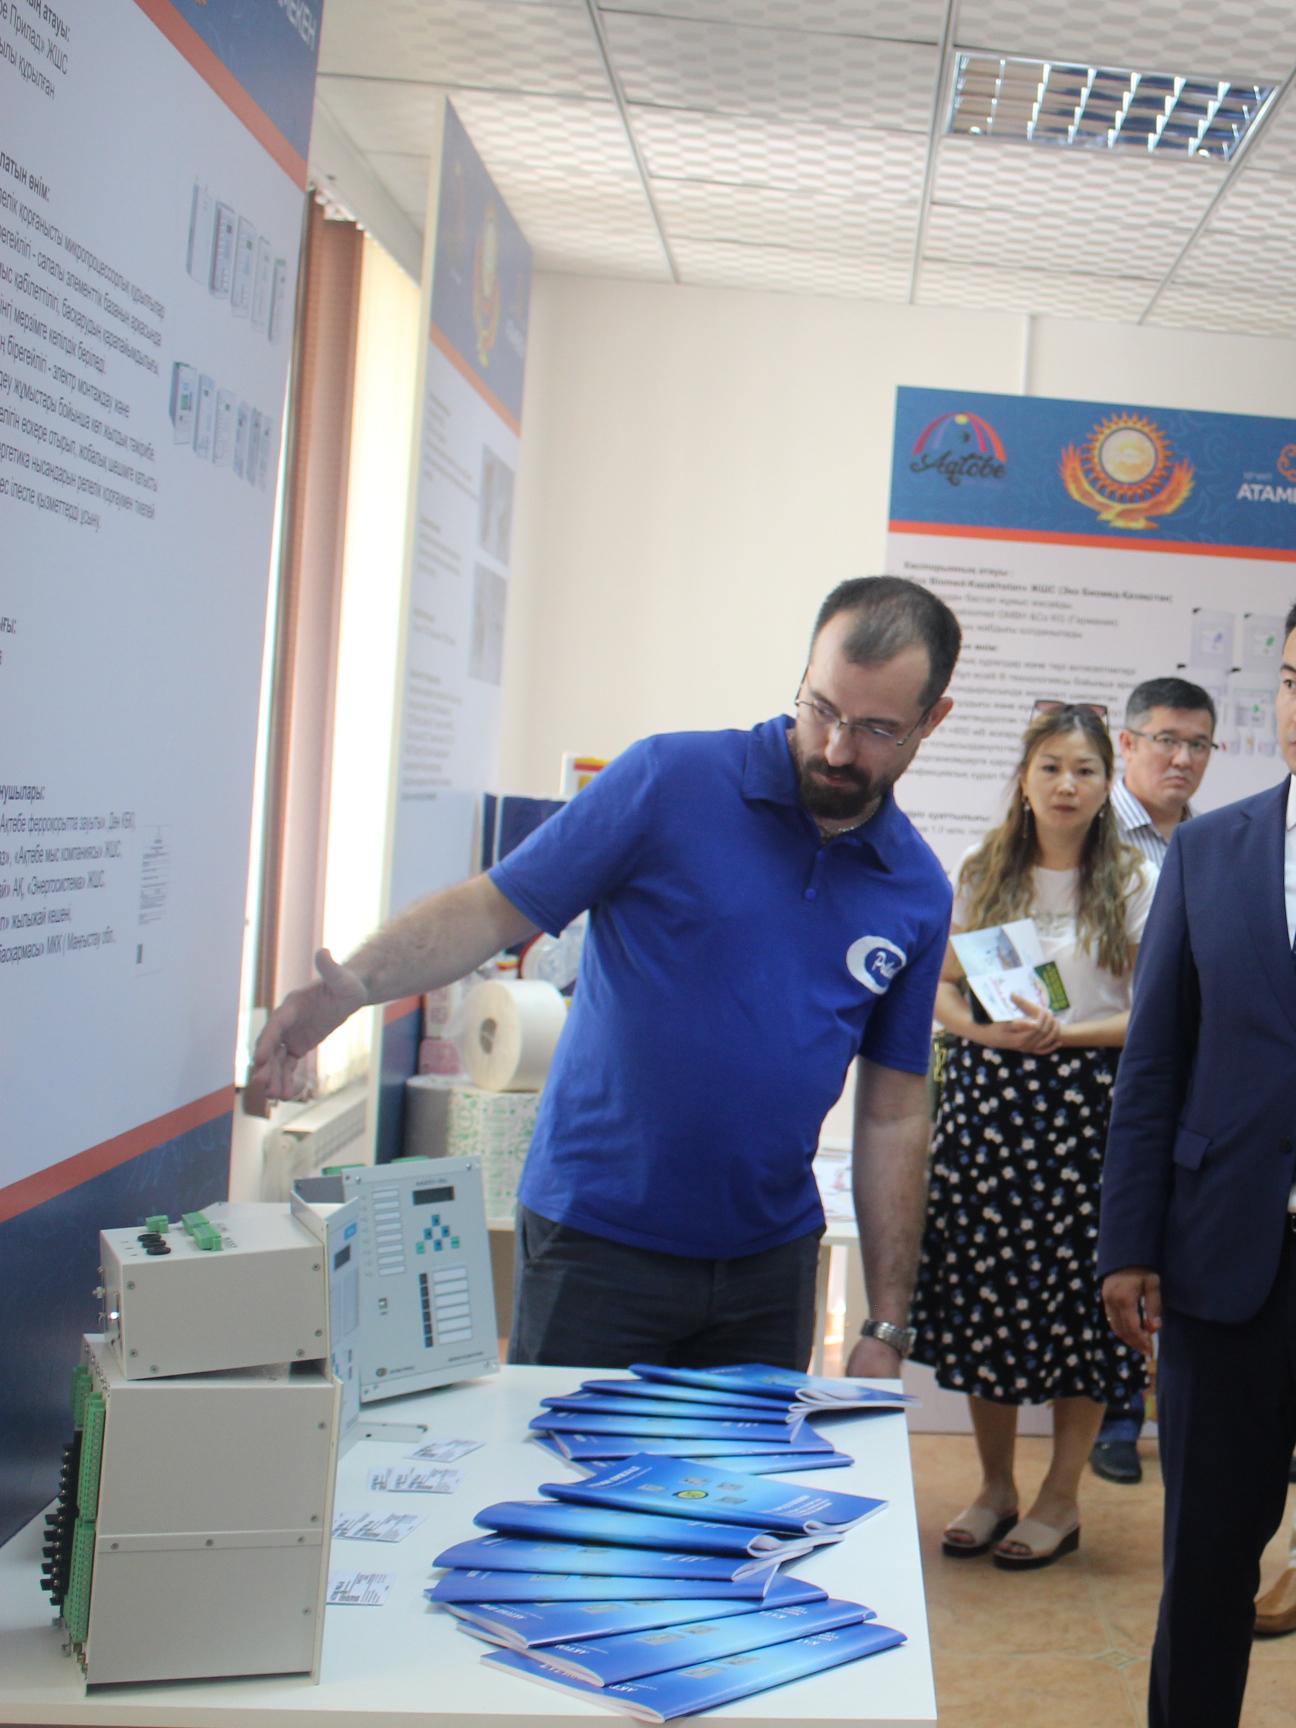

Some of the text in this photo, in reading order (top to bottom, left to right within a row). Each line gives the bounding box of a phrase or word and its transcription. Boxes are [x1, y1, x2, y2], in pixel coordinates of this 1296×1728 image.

[43, 4, 71, 43] атауы:
[46, 38, 69, 75] ЖШС
[29, 175, 50, 202] өнім:
